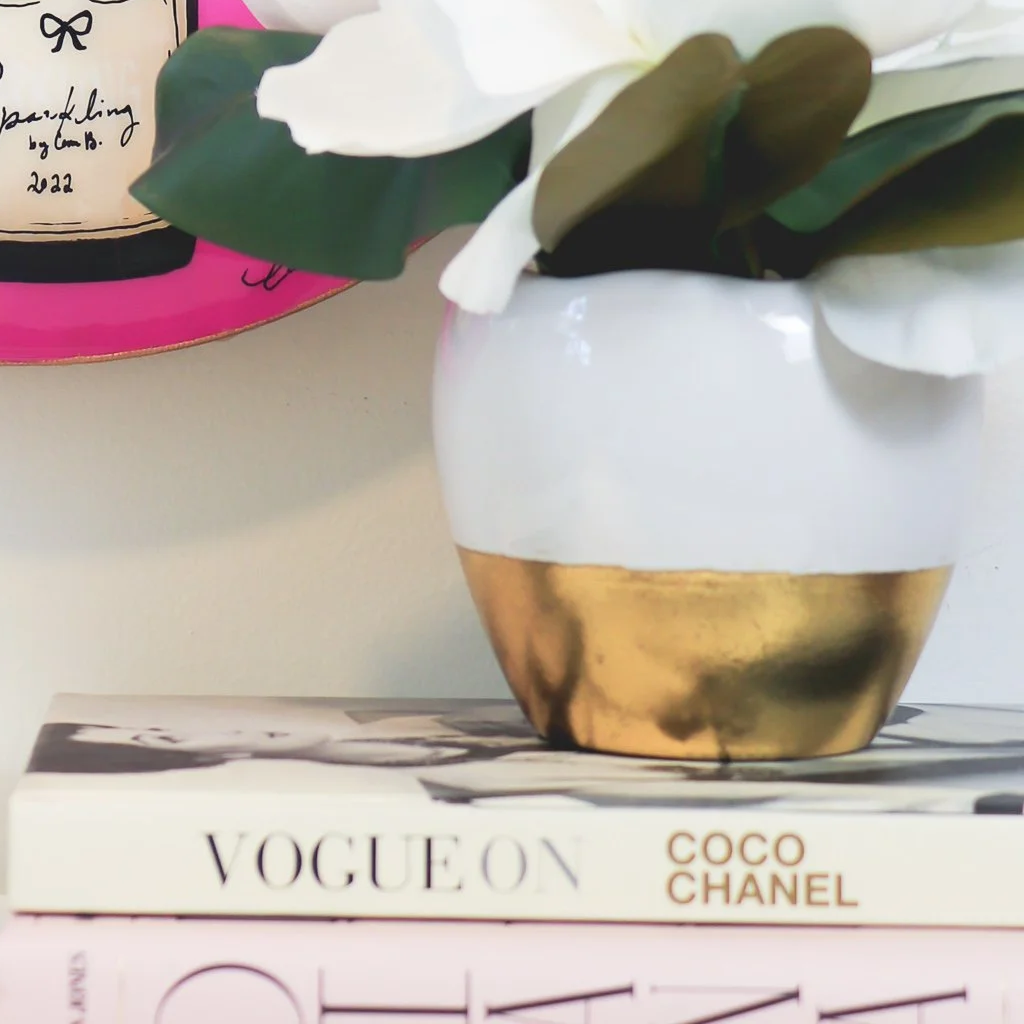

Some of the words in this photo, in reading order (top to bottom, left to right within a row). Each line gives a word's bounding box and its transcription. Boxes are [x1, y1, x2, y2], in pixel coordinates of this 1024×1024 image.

[29, 135, 49, 160] by
[27, 171, 73, 194] 2022
[202, 831, 463, 892] VOGUE
[480, 834, 584, 894] ON
[667, 831, 805, 866] COCO
[666, 871, 859, 908] CHANEL
